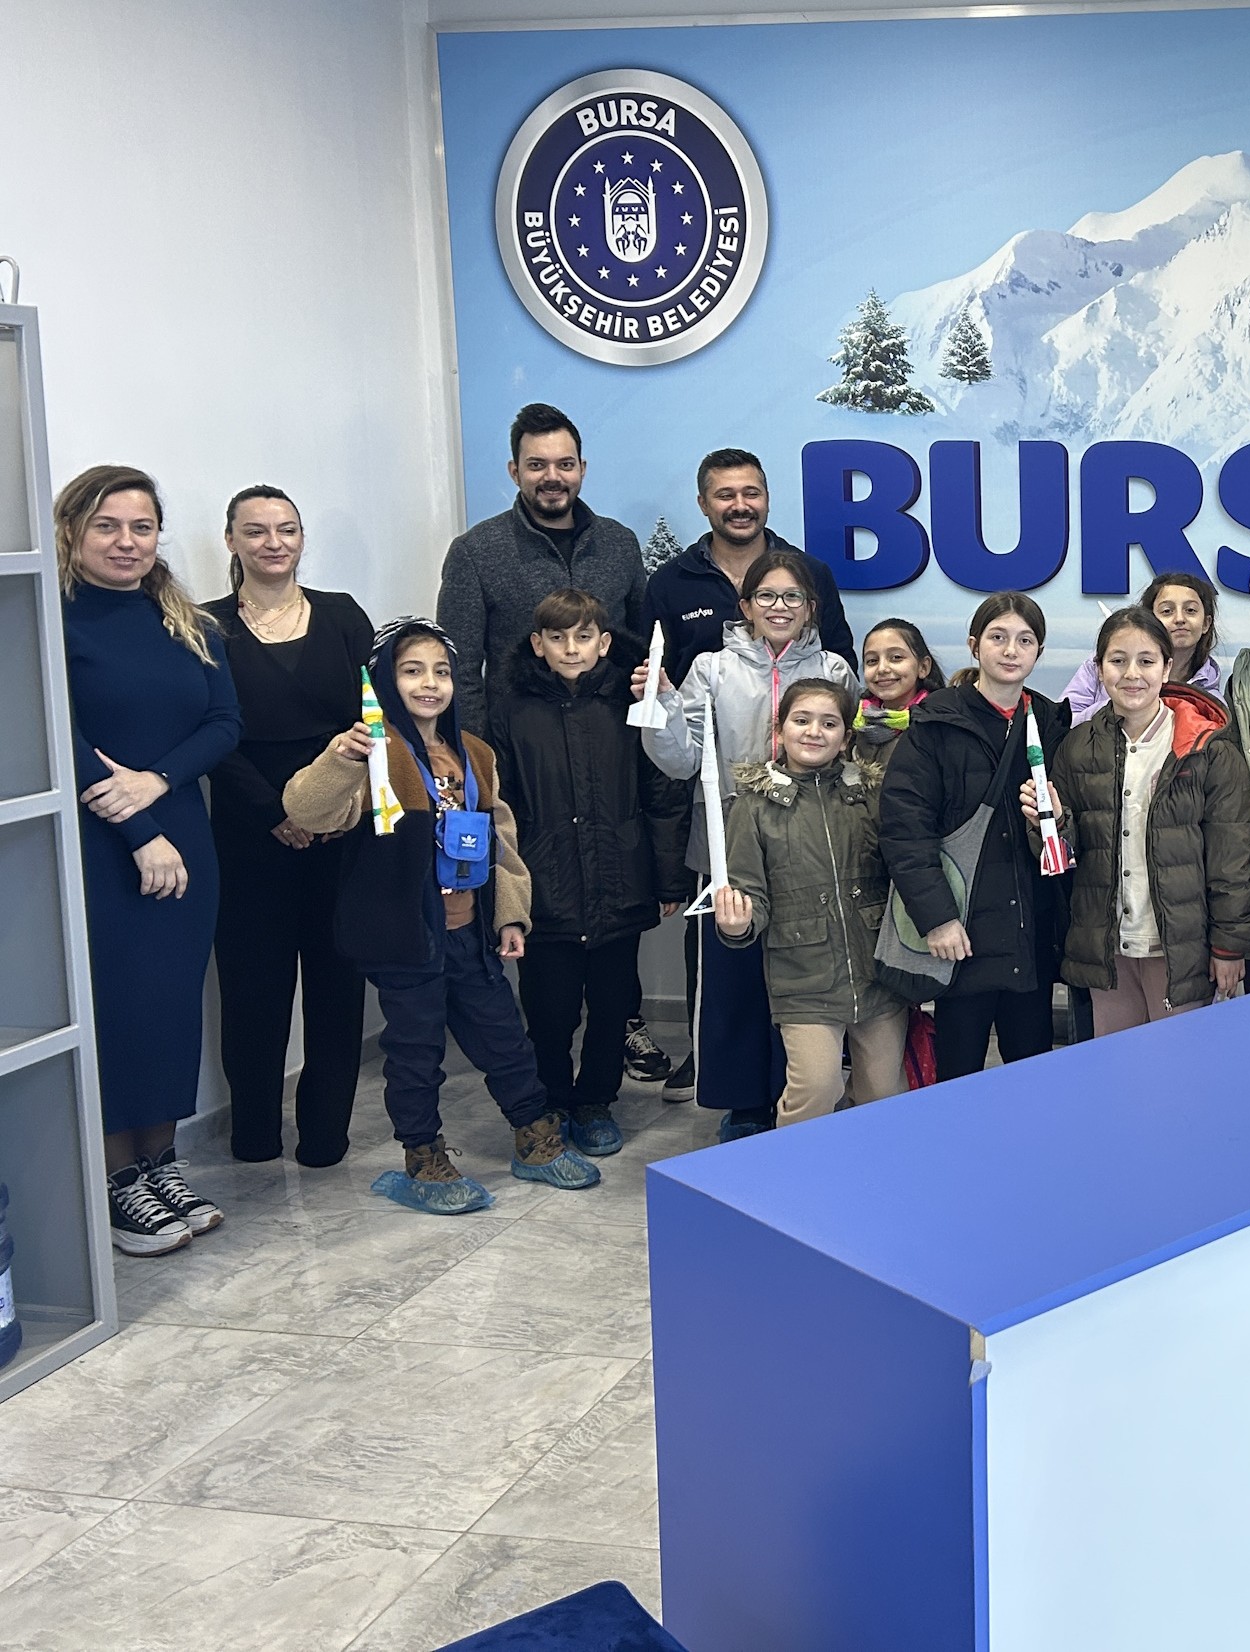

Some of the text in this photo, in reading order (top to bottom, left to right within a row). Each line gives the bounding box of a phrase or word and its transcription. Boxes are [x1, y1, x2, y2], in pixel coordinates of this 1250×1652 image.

[575, 98, 677, 138] BURSA
[523, 205, 740, 339] BÜYÜKŞEHİR BELEDİYESİ
